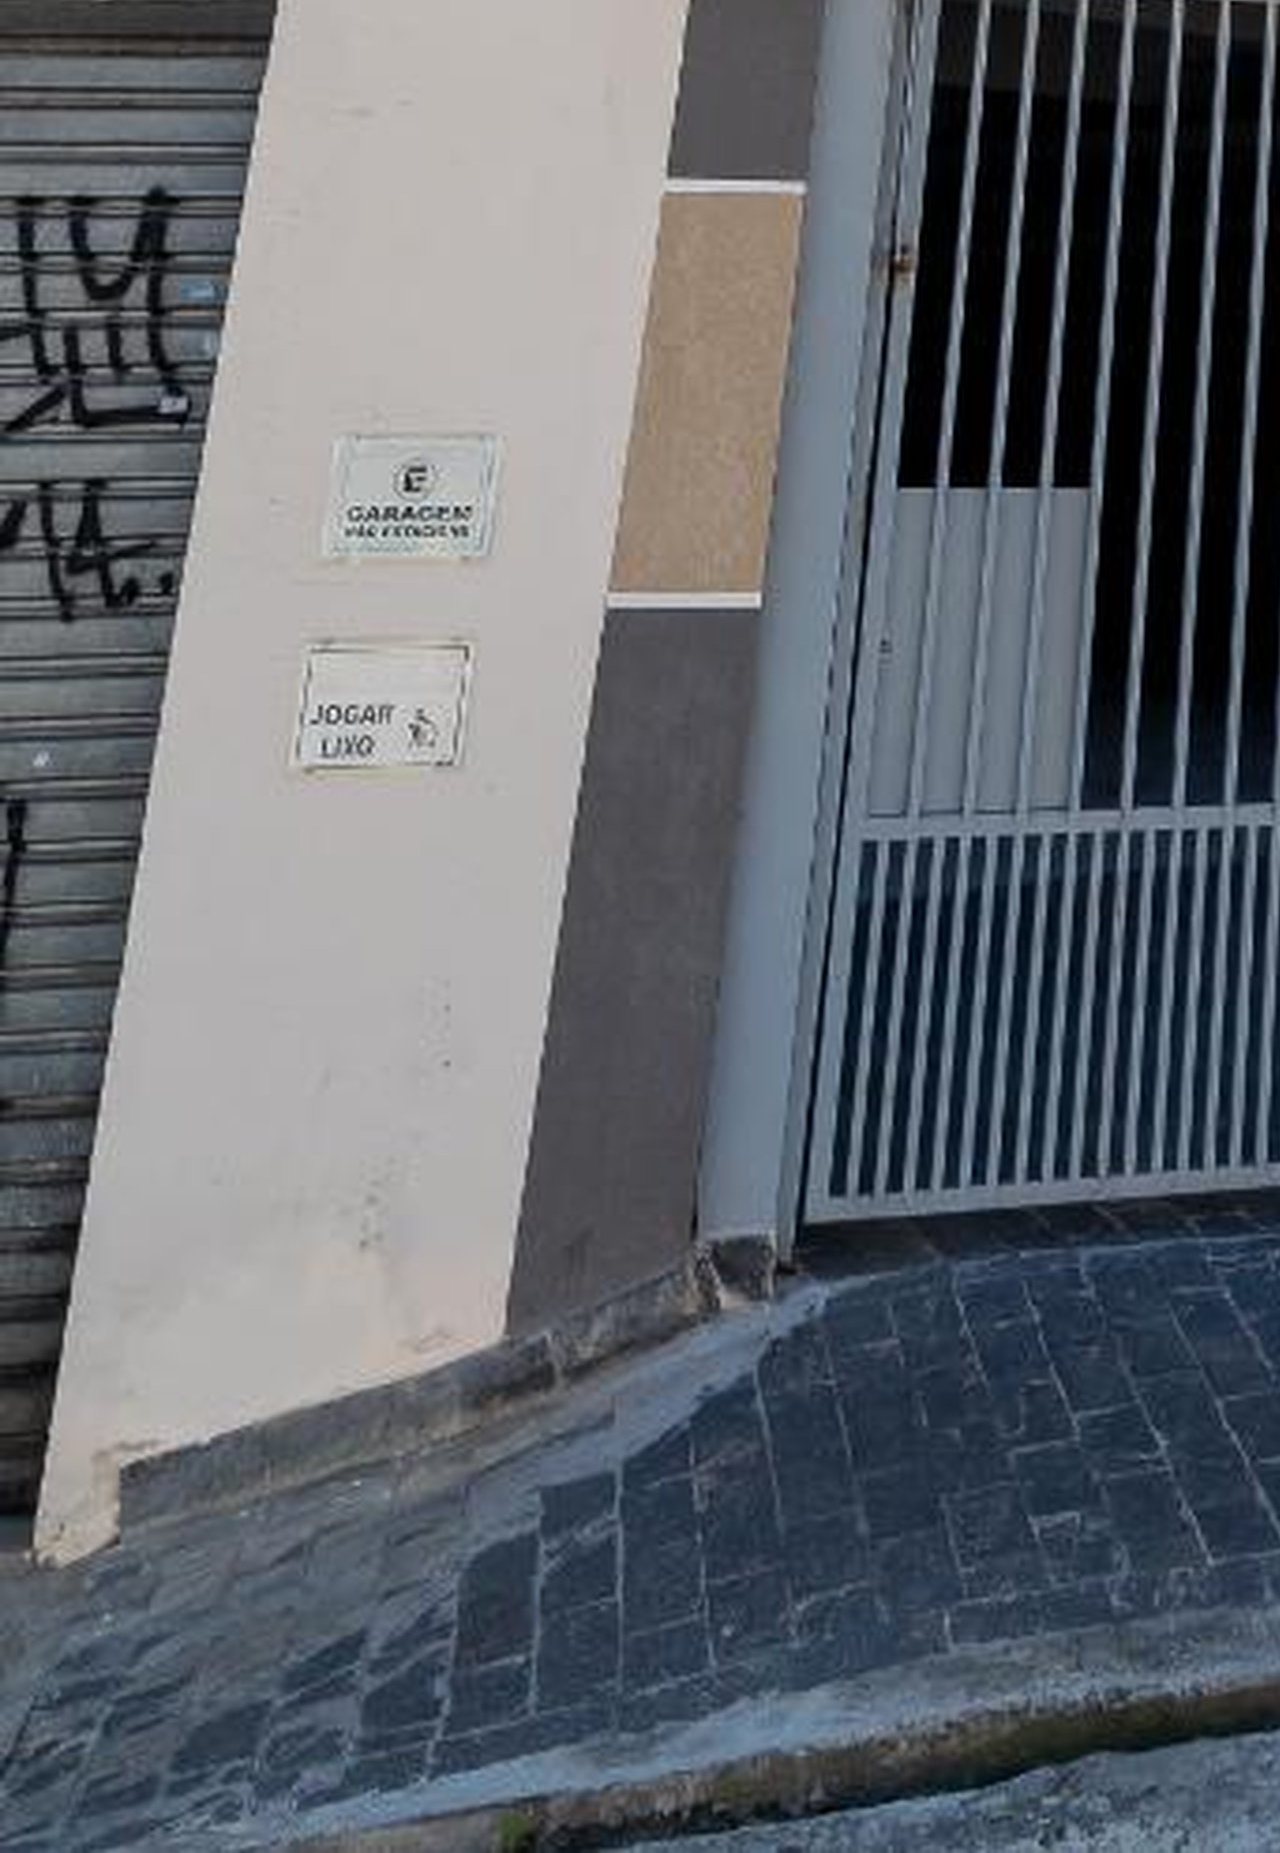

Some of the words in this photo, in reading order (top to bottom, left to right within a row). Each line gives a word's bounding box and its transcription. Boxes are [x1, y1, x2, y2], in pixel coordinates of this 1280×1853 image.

[346, 505, 472, 522] GARAGEM
[310, 704, 395, 726] JOGAR
[321, 734, 376, 758] LIXO
